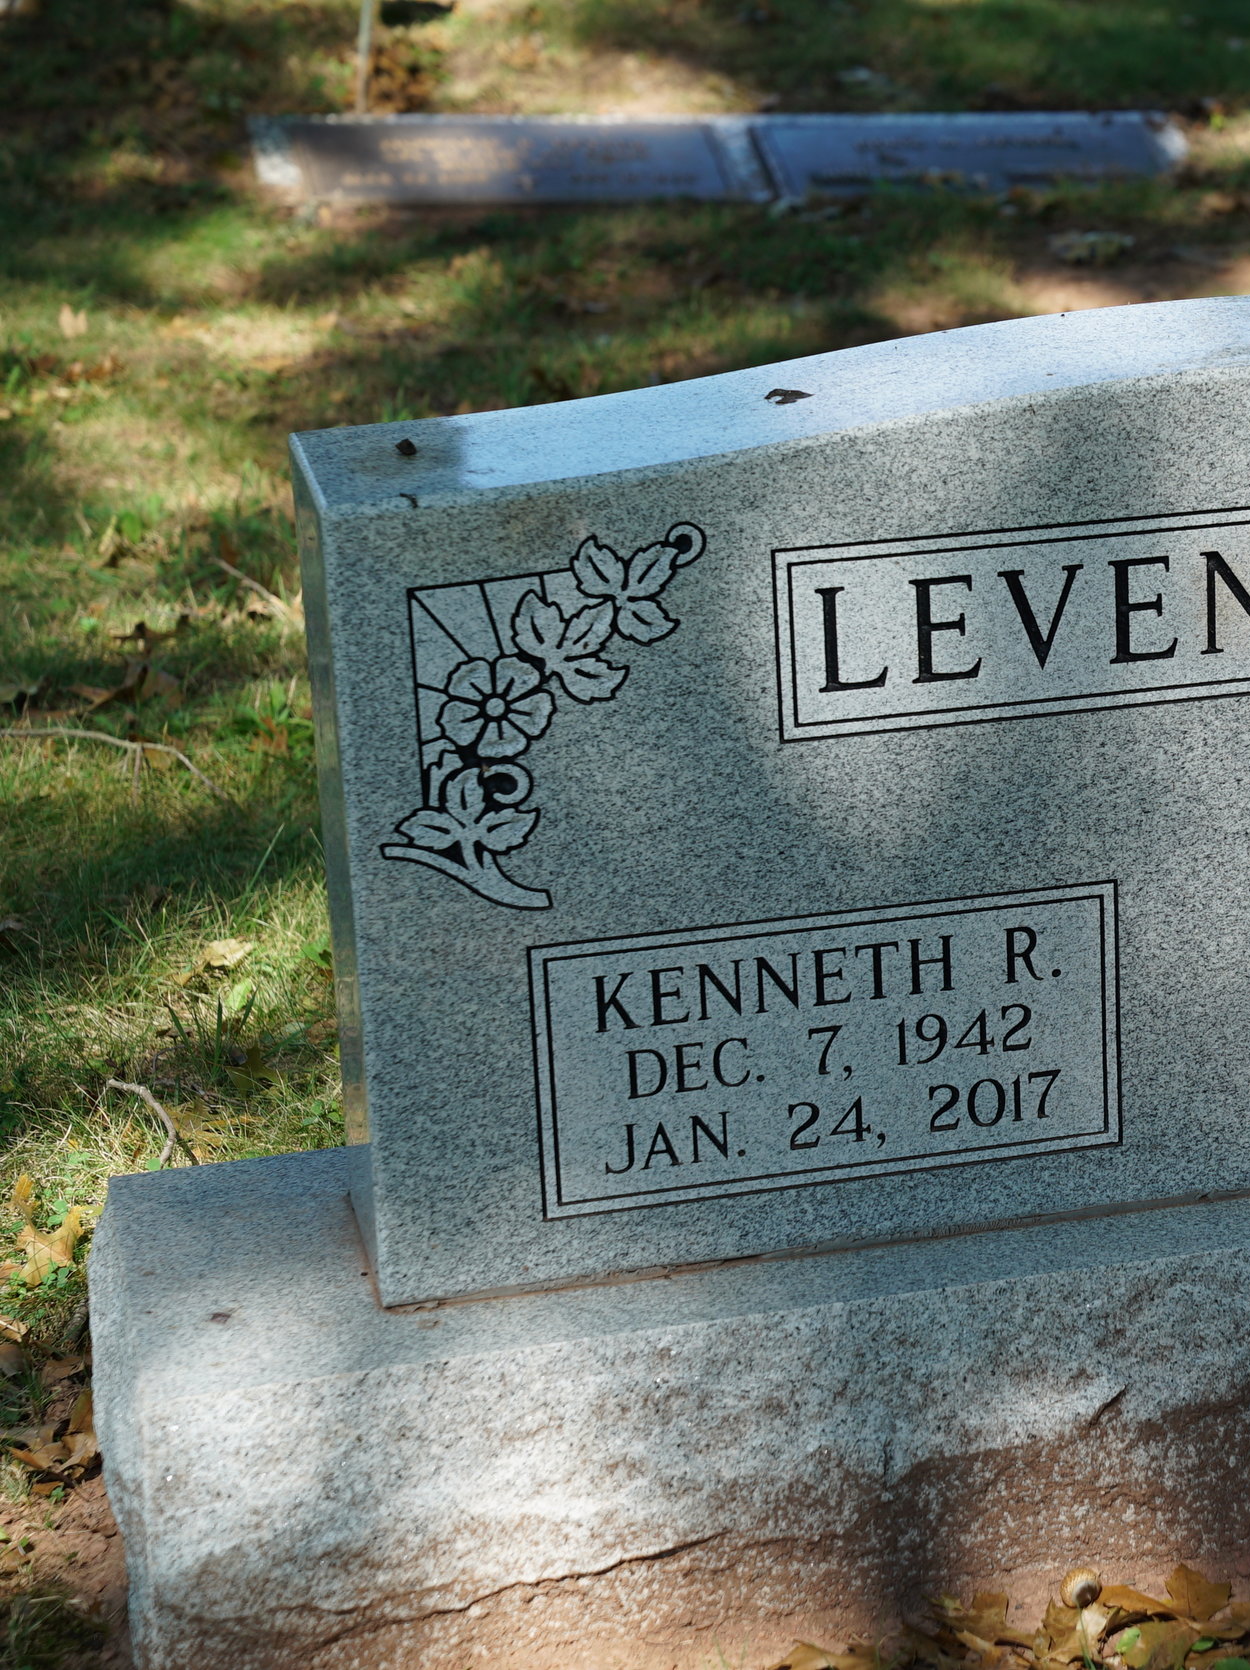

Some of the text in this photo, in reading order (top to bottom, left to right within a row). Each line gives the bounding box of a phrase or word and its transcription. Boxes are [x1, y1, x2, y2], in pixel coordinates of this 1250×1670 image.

[591, 926, 1062, 1033] KENNETH R.
[626, 1003, 1032, 1100] DEC. 7, 1942
[605, 1069, 1062, 1175] JAN. 24, 2017
